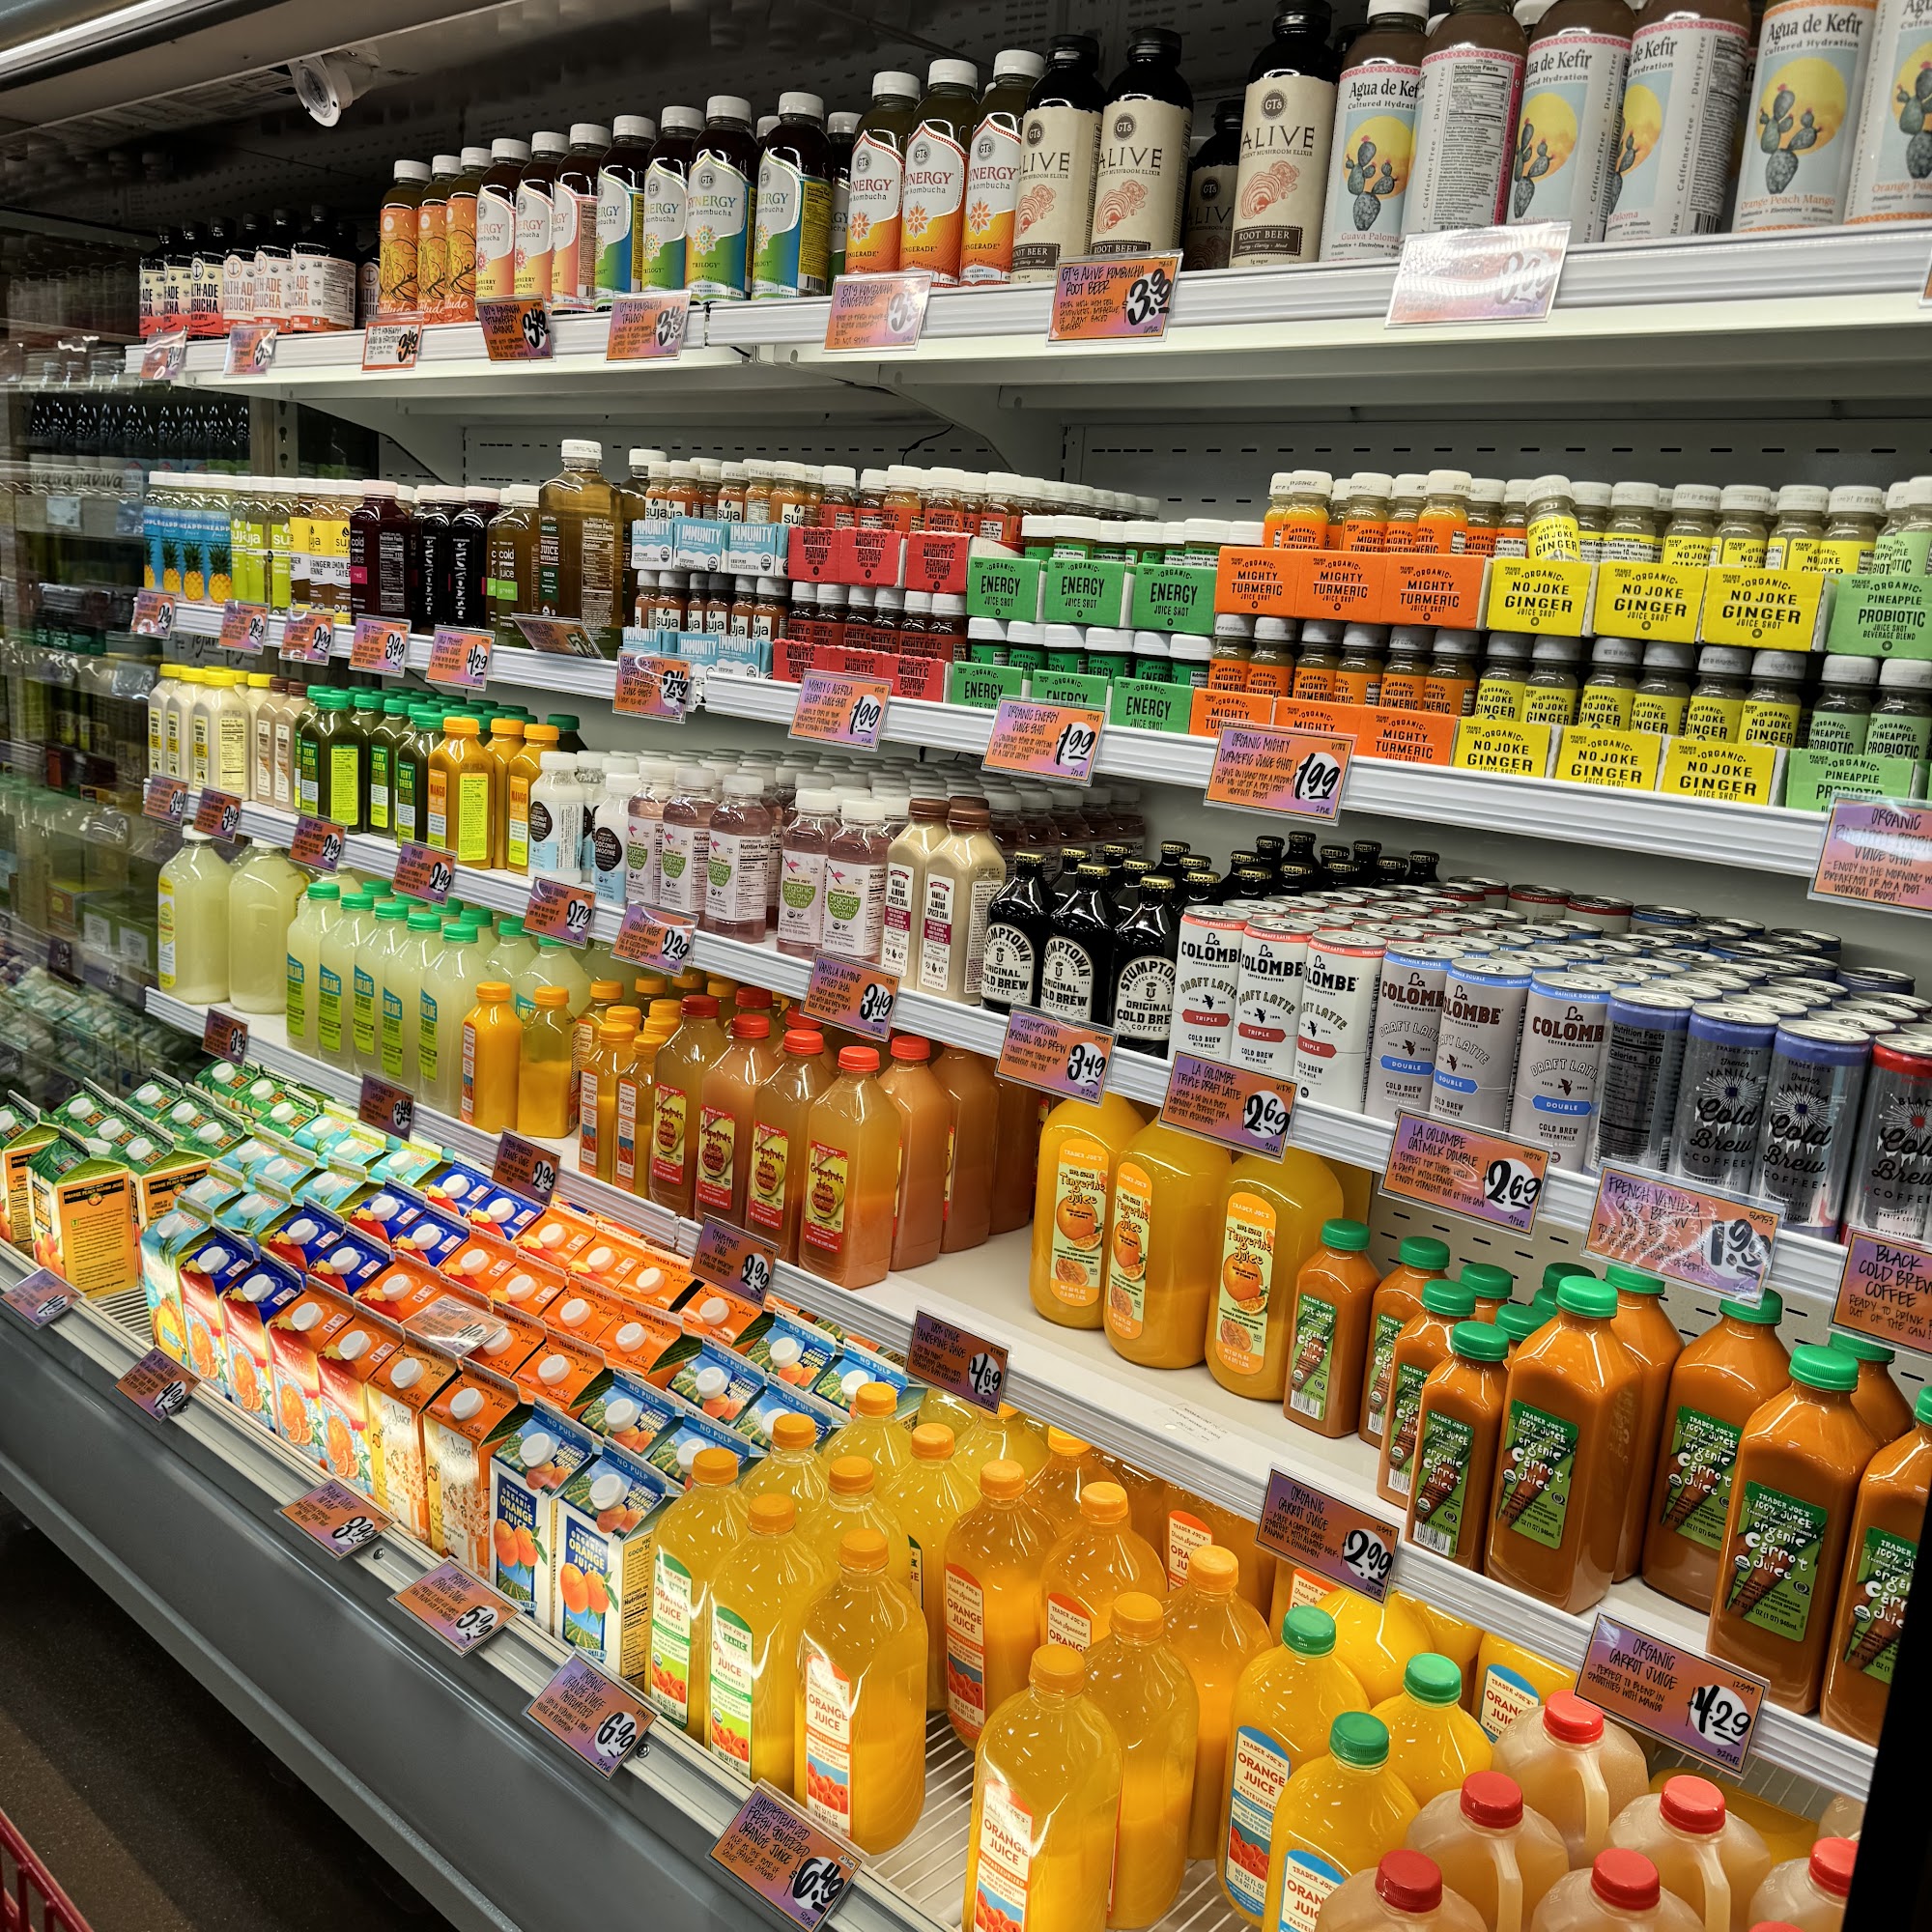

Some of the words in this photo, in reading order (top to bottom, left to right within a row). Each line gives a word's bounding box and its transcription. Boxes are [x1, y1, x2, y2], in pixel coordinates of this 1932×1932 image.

[1766, 19, 1797, 45] Agua
[1803, 15, 1822, 35] de
[1825, 12, 1863, 37] Kefir
[1646, 39, 1679, 58] Kefir
[1764, 42, 1803, 56] Cultured
[1805, 38, 1860, 49] Hydration
[1540, 53, 1556, 71] de
[1559, 48, 1592, 70] Kefir
[1350, 78, 1378, 100] Agua
[1380, 78, 1397, 96] de
[1348, 100, 1381, 110] Cultured
[1241, 127, 1316, 150] ALIVE
[688, 196, 737, 209] SYNERGY
[1741, 197, 1769, 210] Orange
[1770, 194, 1801, 205] Peach
[1803, 194, 1835, 206] Mango
[696, 208, 732, 217] kombucha
[1238, 231, 1263, 242] ROOT
[1264, 230, 1291, 240] BEER
[1081, 268, 1103, 280] ALIVE
[1106, 266, 1145, 278] KOMBUCHA
[1066, 282, 1084, 297] ROOT
[1088, 280, 1111, 295] BEER
[718, 508, 740, 522] suja
[351, 537, 365, 547] cold
[682, 525, 722, 544] IMMUNITY
[730, 526, 773, 542] IMMUNITY
[498, 550, 515, 560] cold
[540, 545, 559, 555] JUICE
[499, 568, 515, 579] juice
[981, 578, 1021, 595] ENERGY
[1061, 578, 1105, 597] ENERGY
[1150, 582, 1198, 605] ENERGY
[1231, 583, 1283, 596] TURMERIC
[1313, 583, 1369, 598] TURMERIC
[1406, 581, 1454, 592] MIGHTY
[1400, 593, 1461, 608] TURMERIC
[1504, 595, 1574, 612] GINGER
[1730, 590, 1750, 602] NO
[1753, 591, 1798, 606] JOKE
[1867, 594, 1922, 606] PINEAPPLE
[1614, 599, 1688, 617] GINGER
[1721, 605, 1802, 625] GINGER
[1858, 609, 1926, 628] PROBIOTIC
[680, 639, 717, 656] IMMUNITY
[1125, 696, 1171, 720] ENERGY
[1232, 733, 1262, 750] ORGANIC
[1263, 737, 1291, 753] MIGHTY
[1746, 727, 1793, 745] GINGER
[373, 753, 385, 762] VERY
[1376, 741, 1434, 758] TURMERIC
[1577, 752, 1598, 761] NO
[1600, 753, 1638, 766] JOKE
[1867, 741, 1919, 758] PROBIOTIC
[1219, 749, 1254, 765] TURMERIC
[1255, 754, 1275, 769] JUICE
[1276, 757, 1294, 771] SHOT
[1466, 753, 1533, 772] GINGER
[399, 771, 412, 780] VERY
[1571, 764, 1642, 783] GINGER
[1825, 771, 1880, 783] PINEAPPLE
[430, 784, 445, 796] MANGO
[1871, 809, 1922, 831] ORGANIC
[782, 884, 813, 895] organic
[828, 894, 859, 906] organic
[828, 902, 859, 914] coconut
[1259, 944, 1273, 958] La
[997, 977, 1029, 991] BREW
[1056, 993, 1088, 1008] BREW
[1020, 1019, 1059, 1038] STUMPTOWN
[1247, 1029, 1269, 1038] TRIPLE
[1391, 1061, 1421, 1070] DOUBLE
[1178, 1072, 1200, 1088] TRIPLE
[1201, 1080, 1220, 1094] DRAFT
[1222, 1084, 1242, 1100] LATTE
[619, 1096, 636, 1107] ORANGE
[621, 1103, 633, 1113] JUICE
[1546, 1101, 1578, 1111] DOUBLE
[1412, 1123, 1423, 1138] LA
[1426, 1127, 1467, 1150] COLOMBE
[1407, 1137, 1443, 1156] OATMILK
[1446, 1148, 1479, 1168] DOUBLE
[1691, 1151, 1747, 1168] COFFEE
[1762, 1144, 1826, 1175] Brew
[1060, 1173, 1105, 1192] Tangerine
[1763, 1169, 1818, 1189] COFFEE
[1876, 1245, 1923, 1270] BLACK
[1859, 1260, 1892, 1283] COLD
[1865, 1281, 1917, 1308] COFFEE
[788, 1323, 799, 1333] NO
[801, 1330, 819, 1343] PULP
[860, 1356, 870, 1365] NO
[872, 1362, 891, 1375] PULP
[1428, 1472, 1453, 1492] Juice
[1519, 1468, 1549, 1491] Juice
[1685, 1472, 1718, 1496] Juice
[502, 1487, 531, 1513] ORGANIC
[1291, 1486, 1324, 1515] ORGANIC
[499, 1497, 534, 1524] ORANGE
[1278, 1497, 1304, 1520] CARROT
[1306, 1510, 1329, 1531] JUICE
[1173, 1522, 1191, 1534] TRADER
[571, 1528, 605, 1555] ORGANIC
[1881, 1540, 1912, 1556] TRADER
[569, 1539, 605, 1570] ORANGE
[1753, 1554, 1792, 1580] Juice
[659, 1603, 682, 1622] JUICE
[947, 1598, 982, 1626] ORANGE
[952, 1612, 976, 1634] JUICE
[1634, 1638, 1676, 1671] ORGANIC
[718, 1658, 742, 1678] JUICE
[1609, 1648, 1645, 1676] CARROT
[1646, 1666, 1678, 1690] JUICE
[1596, 1664, 1623, 1684] PERFECT
[1624, 1676, 1632, 1688] TO
[1634, 1681, 1655, 1697] BLEND
[809, 1692, 848, 1721] ORANGE
[1622, 1688, 1637, 1702] WITH
[1638, 1696, 1662, 1713] MANGO
[814, 1711, 840, 1732] JUICE
[1236, 1751, 1286, 1787] ORANGE
[1243, 1770, 1276, 1798] JUICE
[754, 1796, 810, 1841] UNPASTEURIZED
[745, 1807, 773, 1832] FRESH
[773, 1825, 810, 1858] SQUEEZED
[983, 1818, 1029, 1858] ORANGE
[738, 1822, 771, 1849] ORANGE
[767, 1845, 793, 1864] JUICE
[989, 1838, 1019, 1865] JUICE
[1293, 1865, 1320, 1885] TRADER
